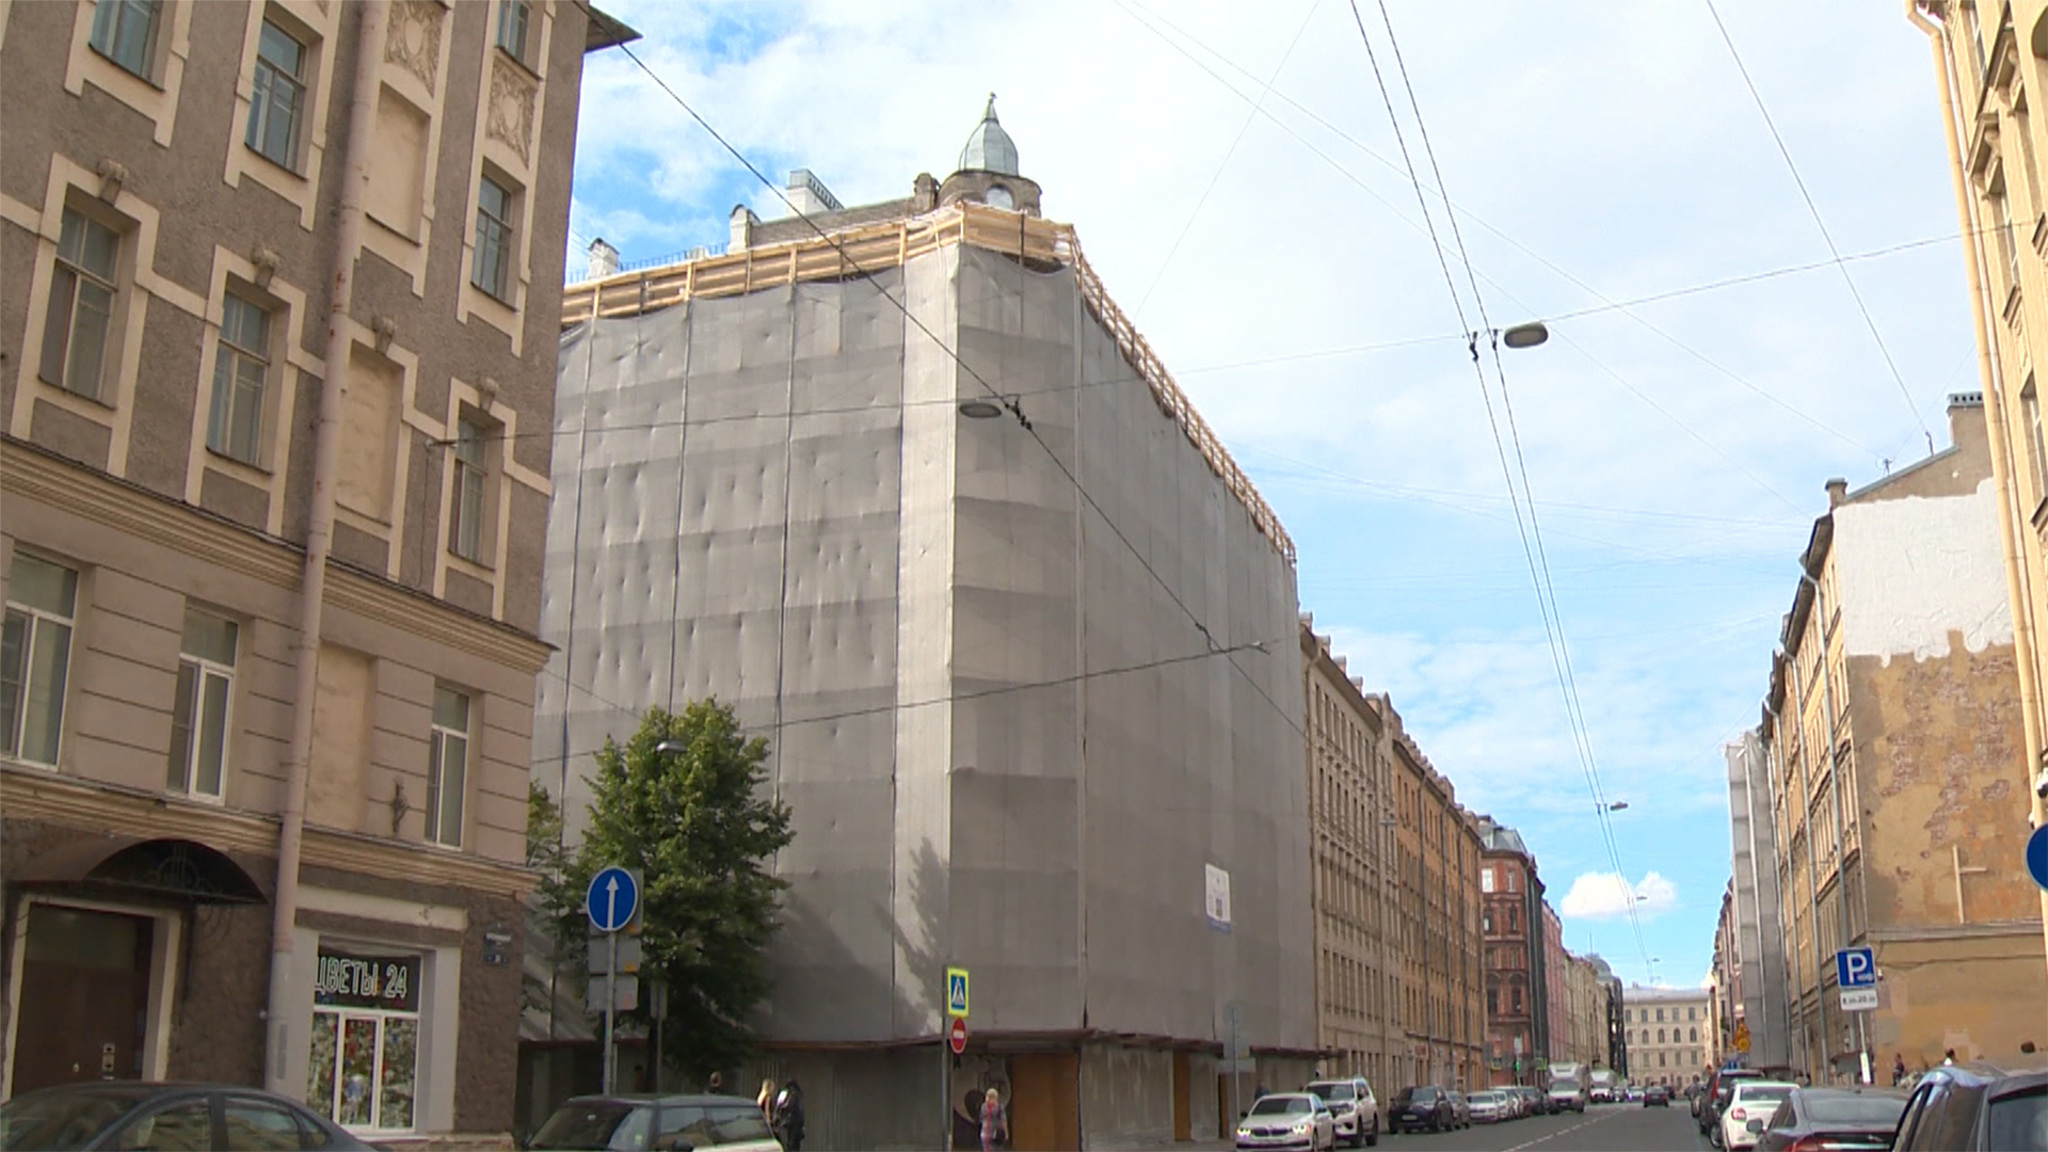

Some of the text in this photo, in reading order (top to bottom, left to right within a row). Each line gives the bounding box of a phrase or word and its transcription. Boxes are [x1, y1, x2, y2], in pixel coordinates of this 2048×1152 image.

[315, 956, 408, 1000] ЦВЕТЫ 24
[1847, 953, 1868, 984] P
